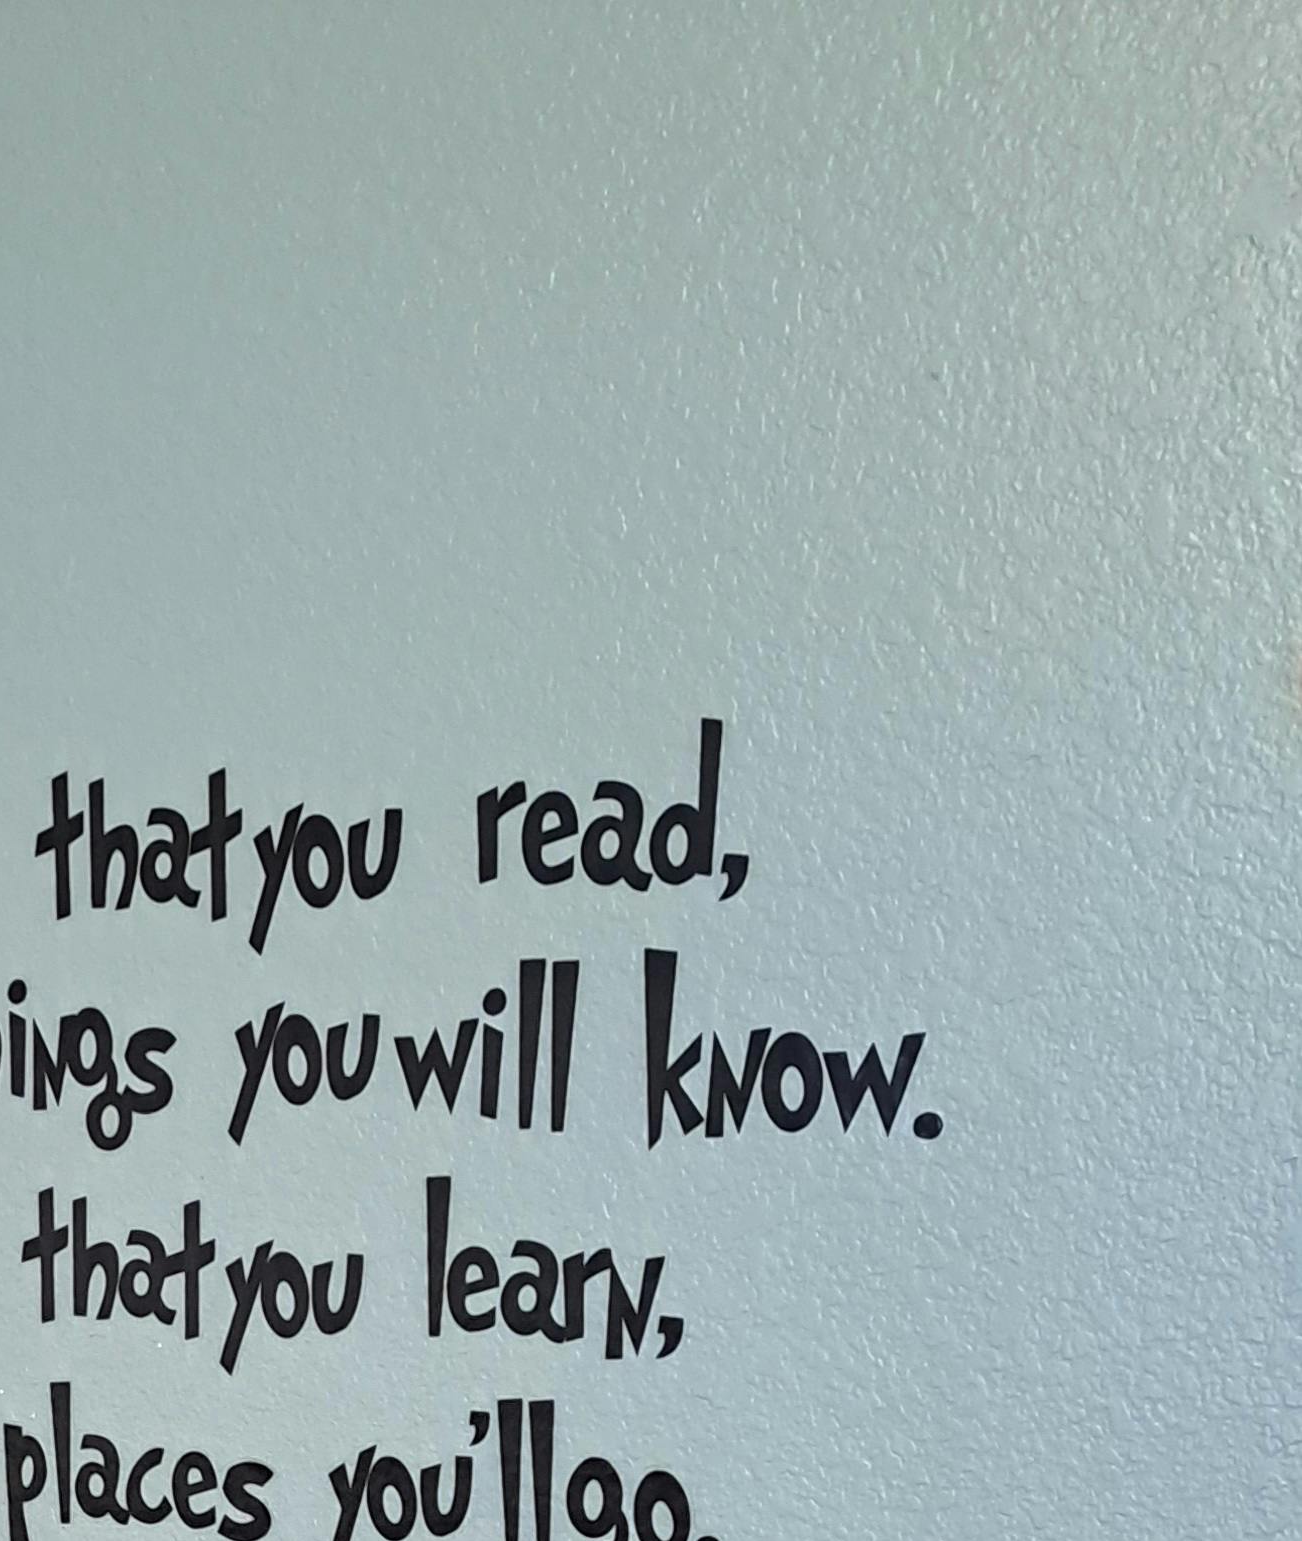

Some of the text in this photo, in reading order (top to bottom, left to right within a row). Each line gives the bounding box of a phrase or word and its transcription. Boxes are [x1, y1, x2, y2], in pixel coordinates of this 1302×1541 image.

[35, 769, 242, 921] that
[249, 804, 402, 955] you
[477, 718, 748, 900] read,
[229, 1003, 379, 1145] you
[394, 959, 579, 1131] will
[22, 1188, 215, 1339] that
[220, 1241, 363, 1374] you
